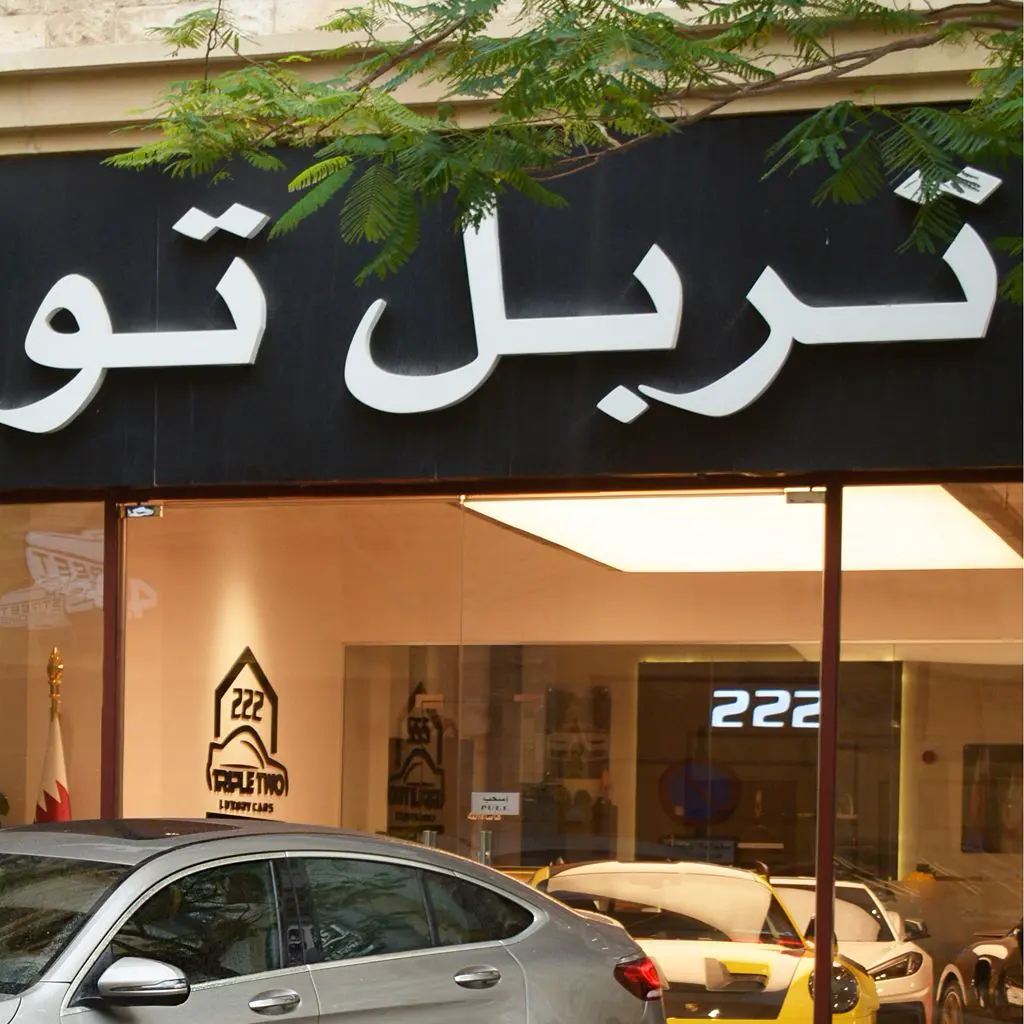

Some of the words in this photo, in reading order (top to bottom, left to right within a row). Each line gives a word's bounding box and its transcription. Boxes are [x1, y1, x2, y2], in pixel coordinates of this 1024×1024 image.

[231, 688, 264, 722] 222
[712, 689, 821, 728] 222
[212, 769, 255, 795] TRIPLE
[256, 772, 285, 797] TWO
[252, 803, 275, 813] CARS
